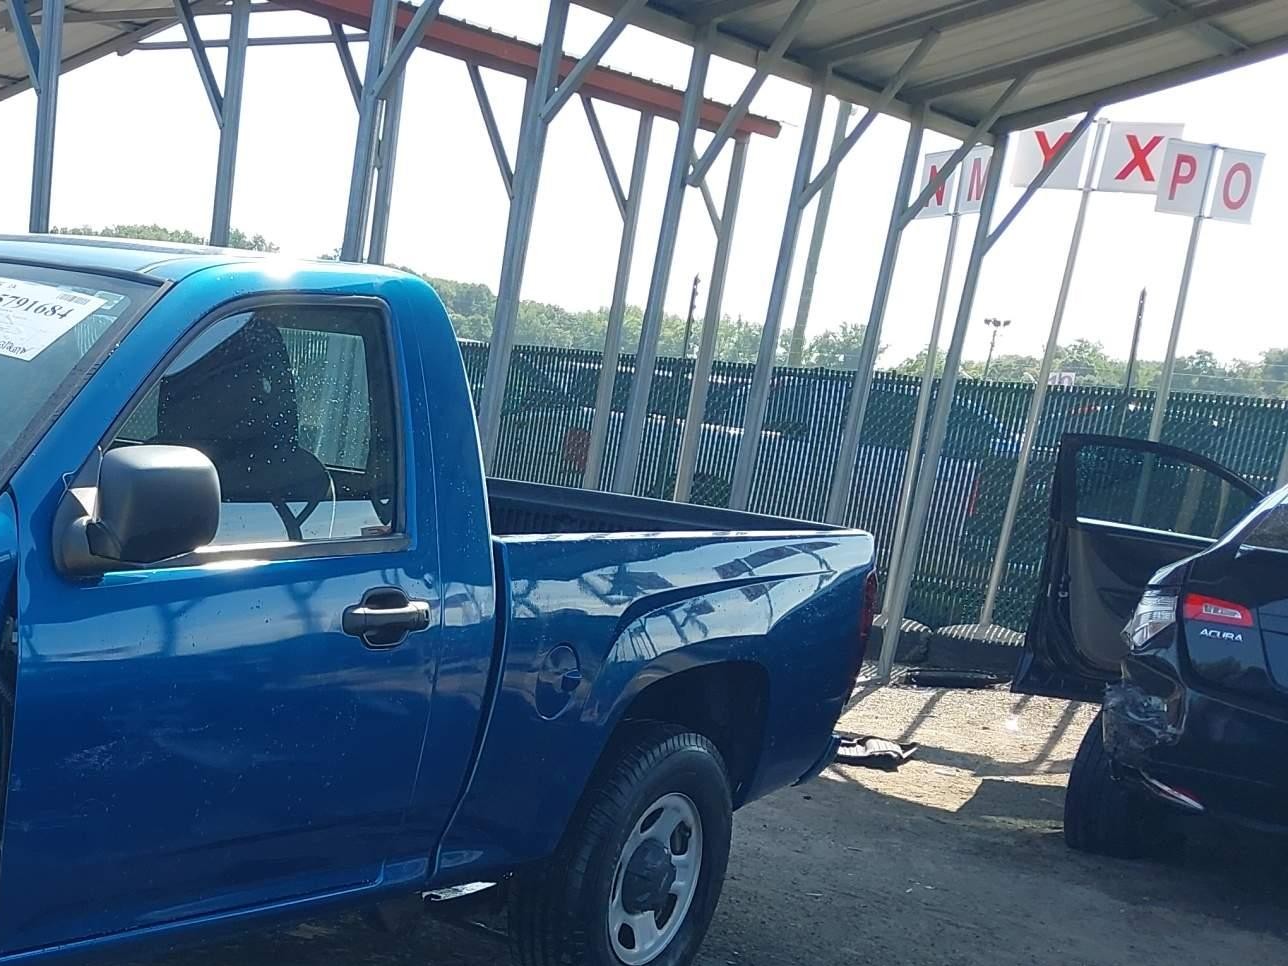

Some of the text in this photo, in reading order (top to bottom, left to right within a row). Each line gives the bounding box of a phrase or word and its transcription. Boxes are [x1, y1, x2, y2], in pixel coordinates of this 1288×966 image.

[1115, 135, 1165, 182] X
[1168, 154, 1197, 200] P
[1223, 162, 1252, 210] O
[1200, 629, 1243, 641] ACURA
